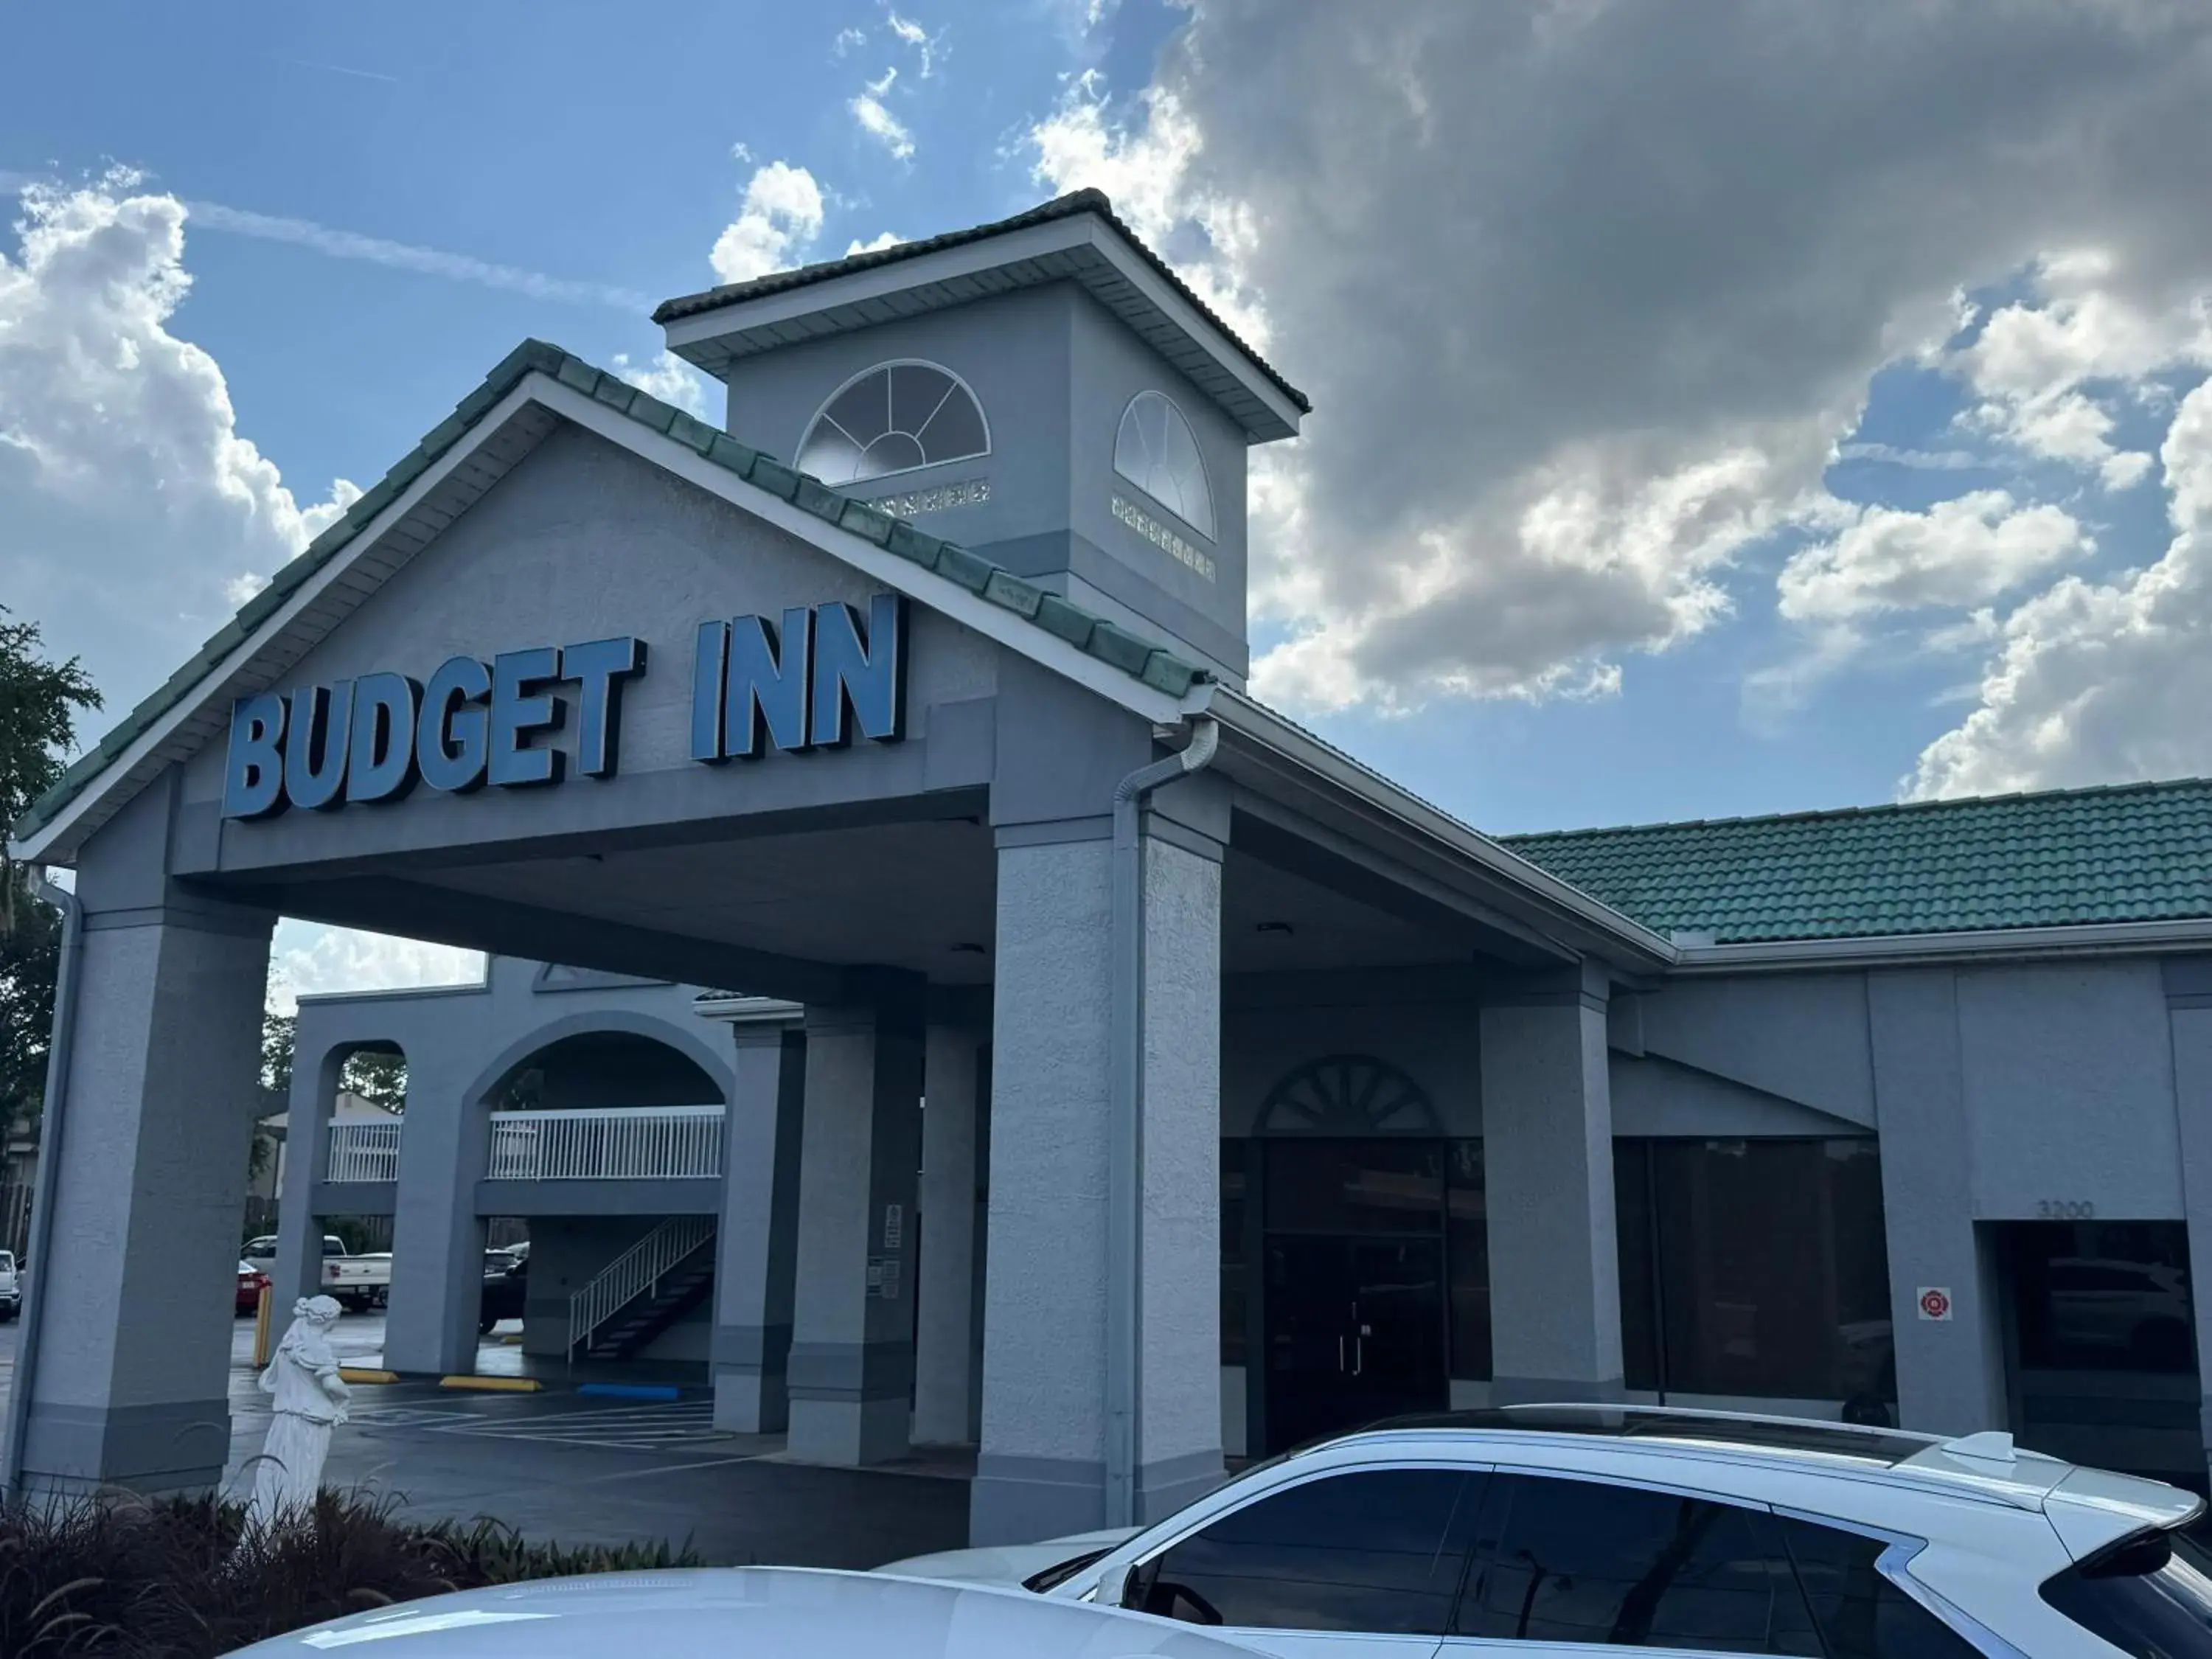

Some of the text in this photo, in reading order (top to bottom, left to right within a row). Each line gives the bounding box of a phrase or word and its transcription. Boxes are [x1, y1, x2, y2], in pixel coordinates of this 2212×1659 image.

[223, 594, 905, 819] BUDGET INN
[2036, 1200, 2095, 1220] 3200
